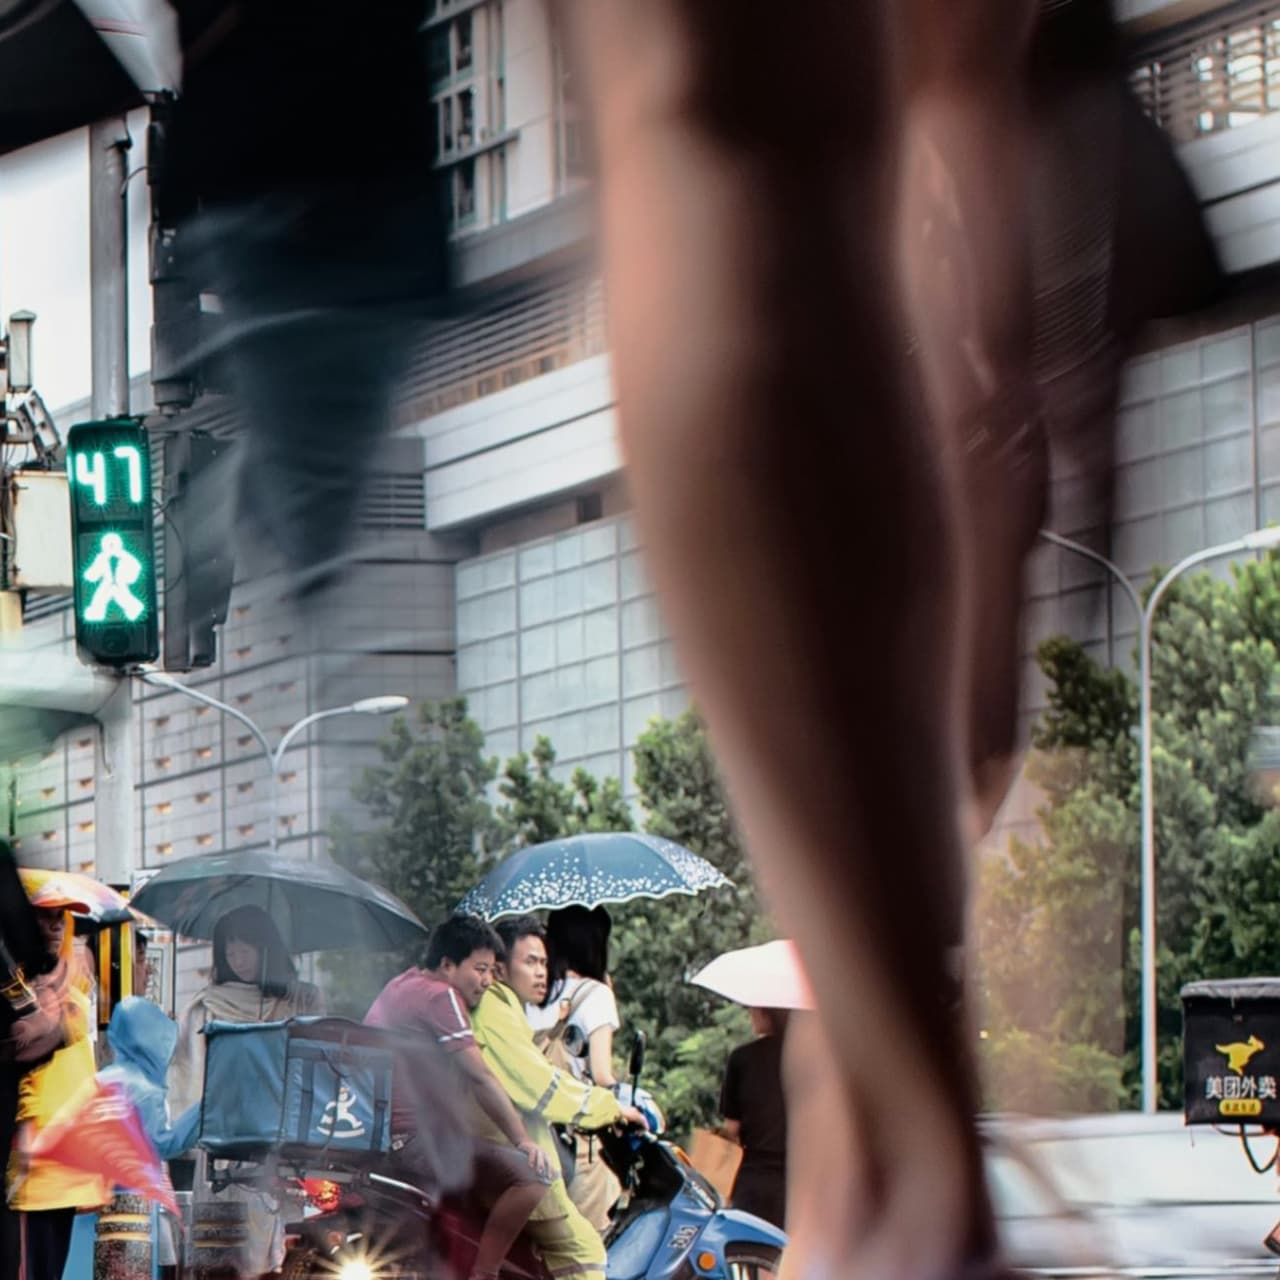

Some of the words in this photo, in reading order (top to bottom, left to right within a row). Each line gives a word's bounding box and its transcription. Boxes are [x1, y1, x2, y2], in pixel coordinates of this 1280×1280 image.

[75, 446, 143, 505] 47
[1204, 1075, 1278, 1100] 美团外卖
